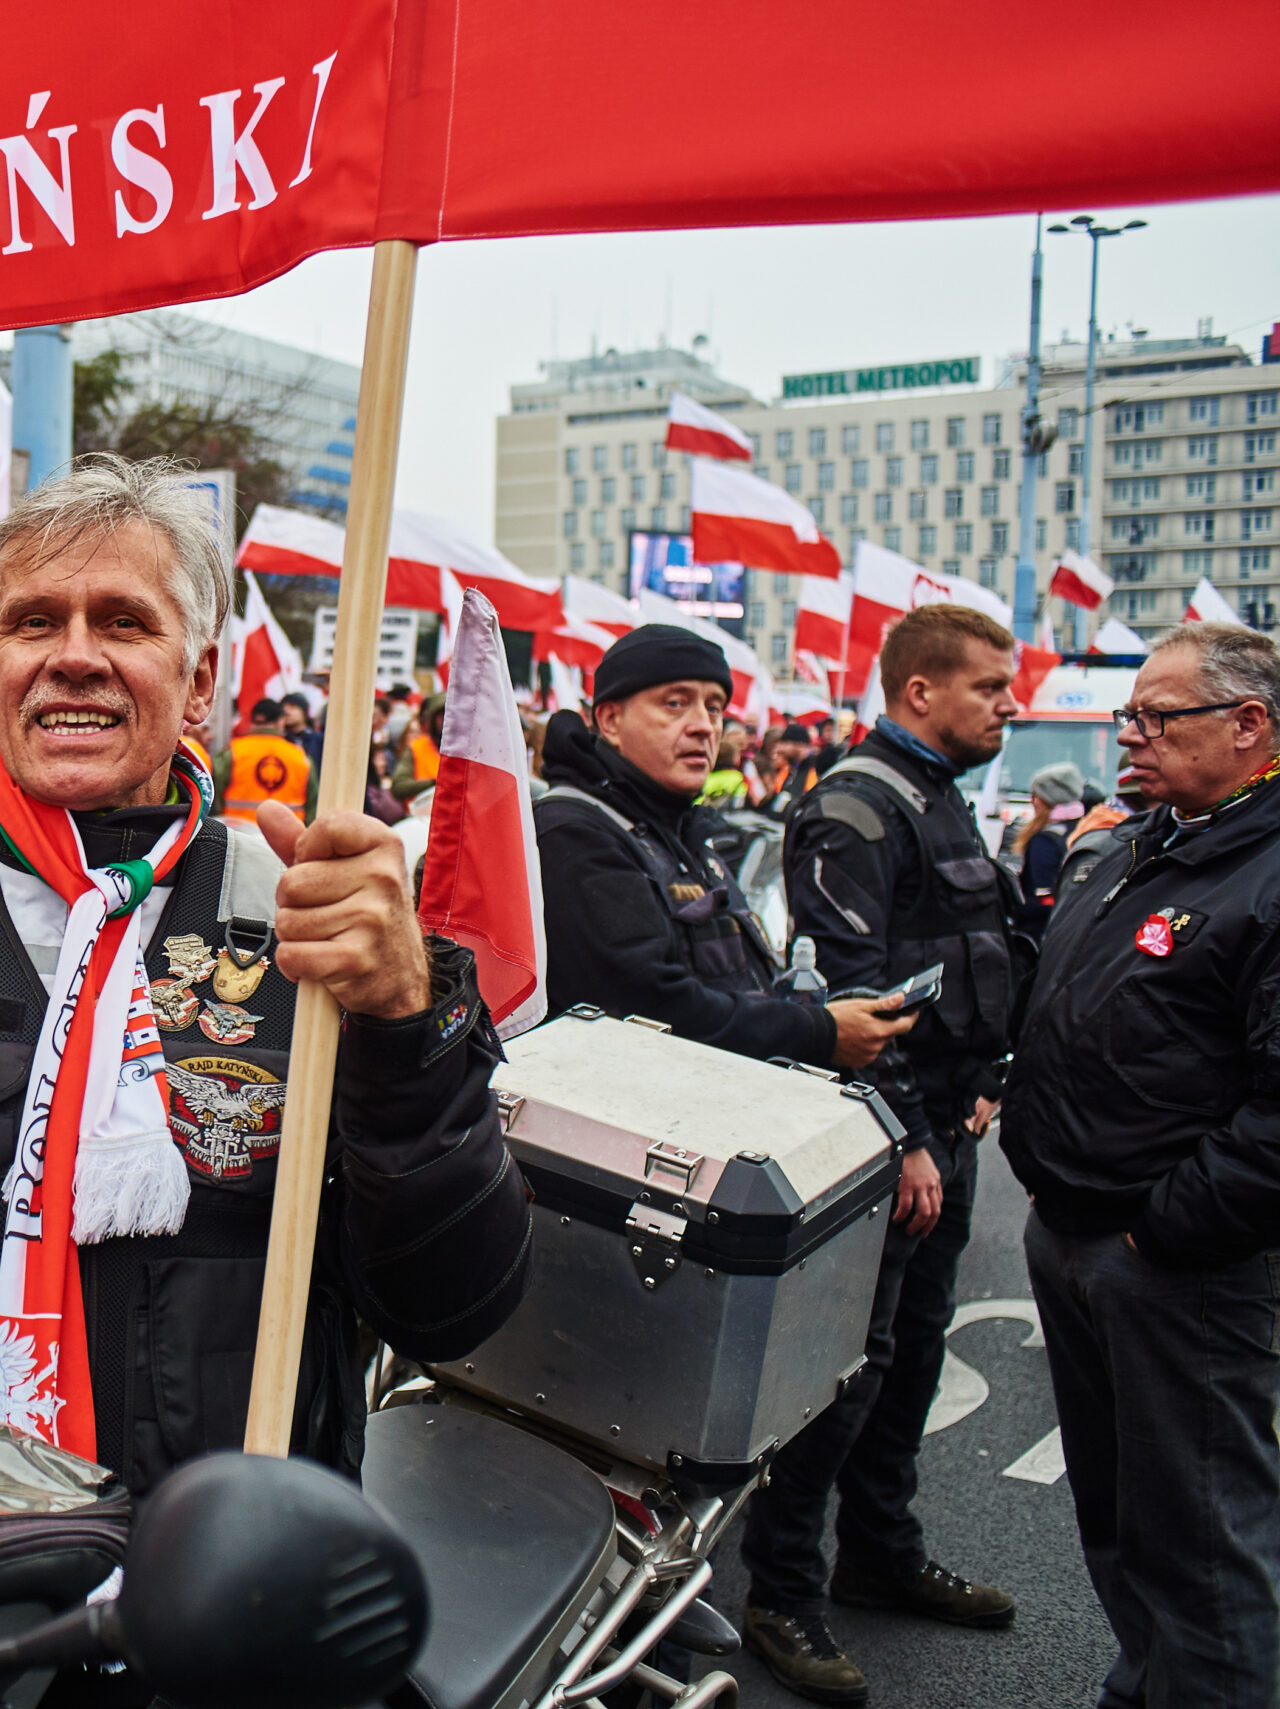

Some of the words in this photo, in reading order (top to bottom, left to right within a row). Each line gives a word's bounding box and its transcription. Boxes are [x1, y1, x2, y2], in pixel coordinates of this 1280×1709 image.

[784, 372, 847, 398] HOTEL
[857, 357, 978, 391] METROPOL
[188, 1061, 213, 1072] RAJD
[216, 1060, 263, 1084] KATYŃSKI
